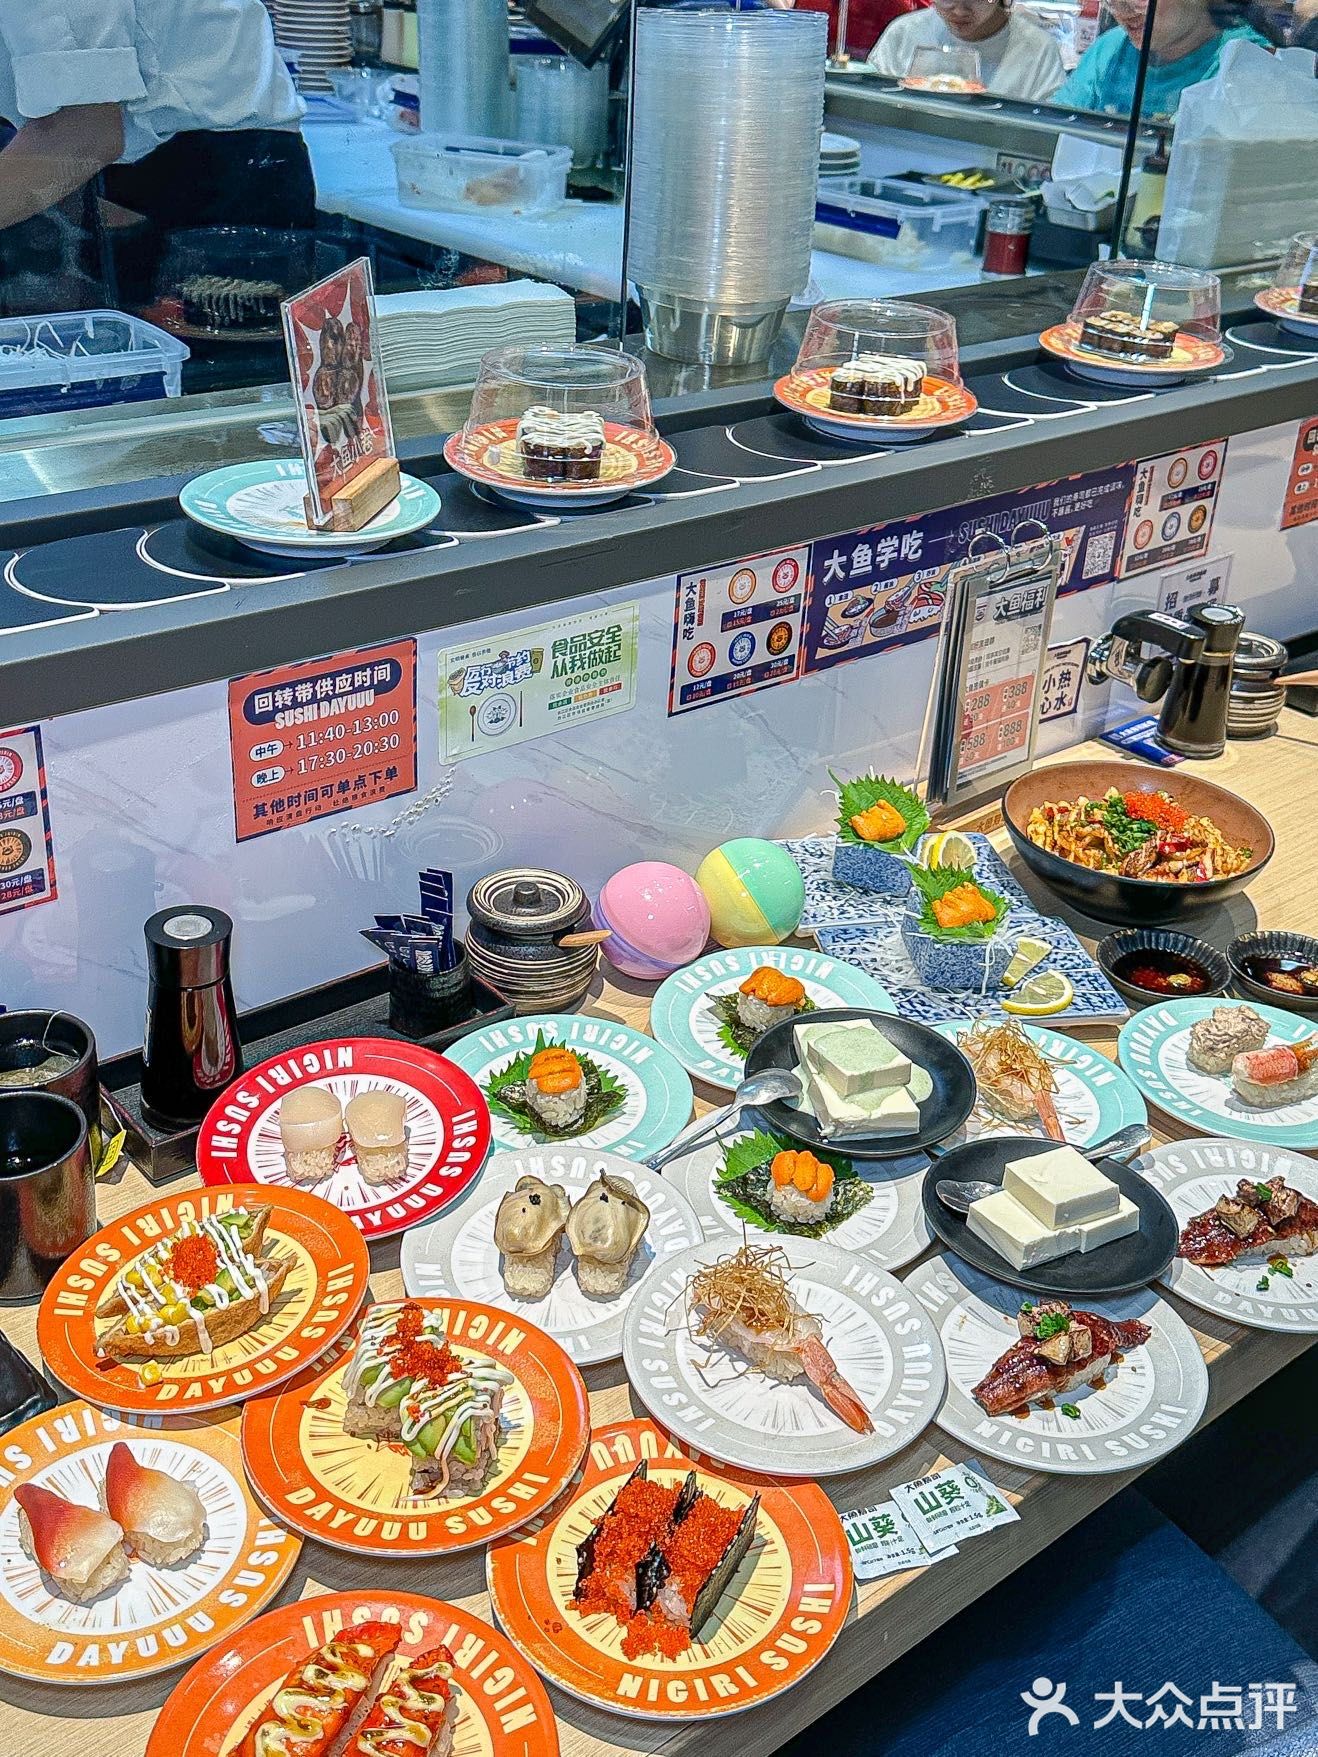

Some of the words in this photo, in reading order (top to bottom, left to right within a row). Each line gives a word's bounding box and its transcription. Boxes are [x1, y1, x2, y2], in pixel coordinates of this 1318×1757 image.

[822, 530, 923, 586] 大鱼学吃
[682, 581, 697, 641] 大鱼嗨吃
[550, 642, 622, 679] 从我做起
[551, 624, 622, 659] 食品安全
[254, 663, 391, 714] 回转带供应时间
[460, 666, 533, 697] 反对浪费
[971, 694, 991, 711] 288
[1008, 682, 1028, 699] 388
[274, 704, 318, 730] SUSHI
[319, 688, 375, 720] DAYUUU
[297, 709, 399, 750] 11:40-13:00
[1003, 720, 1022, 737] 888
[255, 744, 278, 759] 中午
[297, 734, 400, 775] 17:30-20:30
[967, 732, 986, 750] 588
[253, 766, 398, 820] 其他时间可单点下单
[256, 769, 279, 785] 晚上
[674, 955, 739, 994] SUSHI
[478, 1021, 559, 1053] SUSHI
[569, 1018, 655, 1064] NIGIRI
[1129, 1009, 1179, 1065] DAYUUU
[256, 1046, 353, 1094] NIGIRI
[1136, 1068, 1204, 1117] SUSHI
[210, 1089, 262, 1158] SUSHI
[439, 1109, 478, 1178] SUSHI
[120, 1193, 235, 1246] NIGIRI
[53, 1242, 121, 1318] SUSHI
[841, 1265, 922, 1336] SUSHI
[155, 1345, 300, 1401] DAYUUU
[301, 1262, 355, 1340] SUSHI
[639, 1268, 690, 1348] NIGIRI
[641, 1357, 716, 1433] SUSHI
[875, 1342, 932, 1437] DAYUUU
[973, 1419, 1097, 1461] NIGIRI
[1104, 1402, 1189, 1458] SUSHI
[284, 1486, 428, 1541] DAYUUU
[444, 1472, 550, 1536] SUSHI
[913, 1480, 965, 1516] 山葵
[845, 1513, 898, 1547] 山葵
[46, 1611, 216, 1666] DAYUUU
[219, 1516, 289, 1609] SUSHI
[615, 1665, 758, 1704] NIGIRI
[759, 1583, 835, 1671] SUSHI
[444, 1622, 537, 1735] NIGIRI
